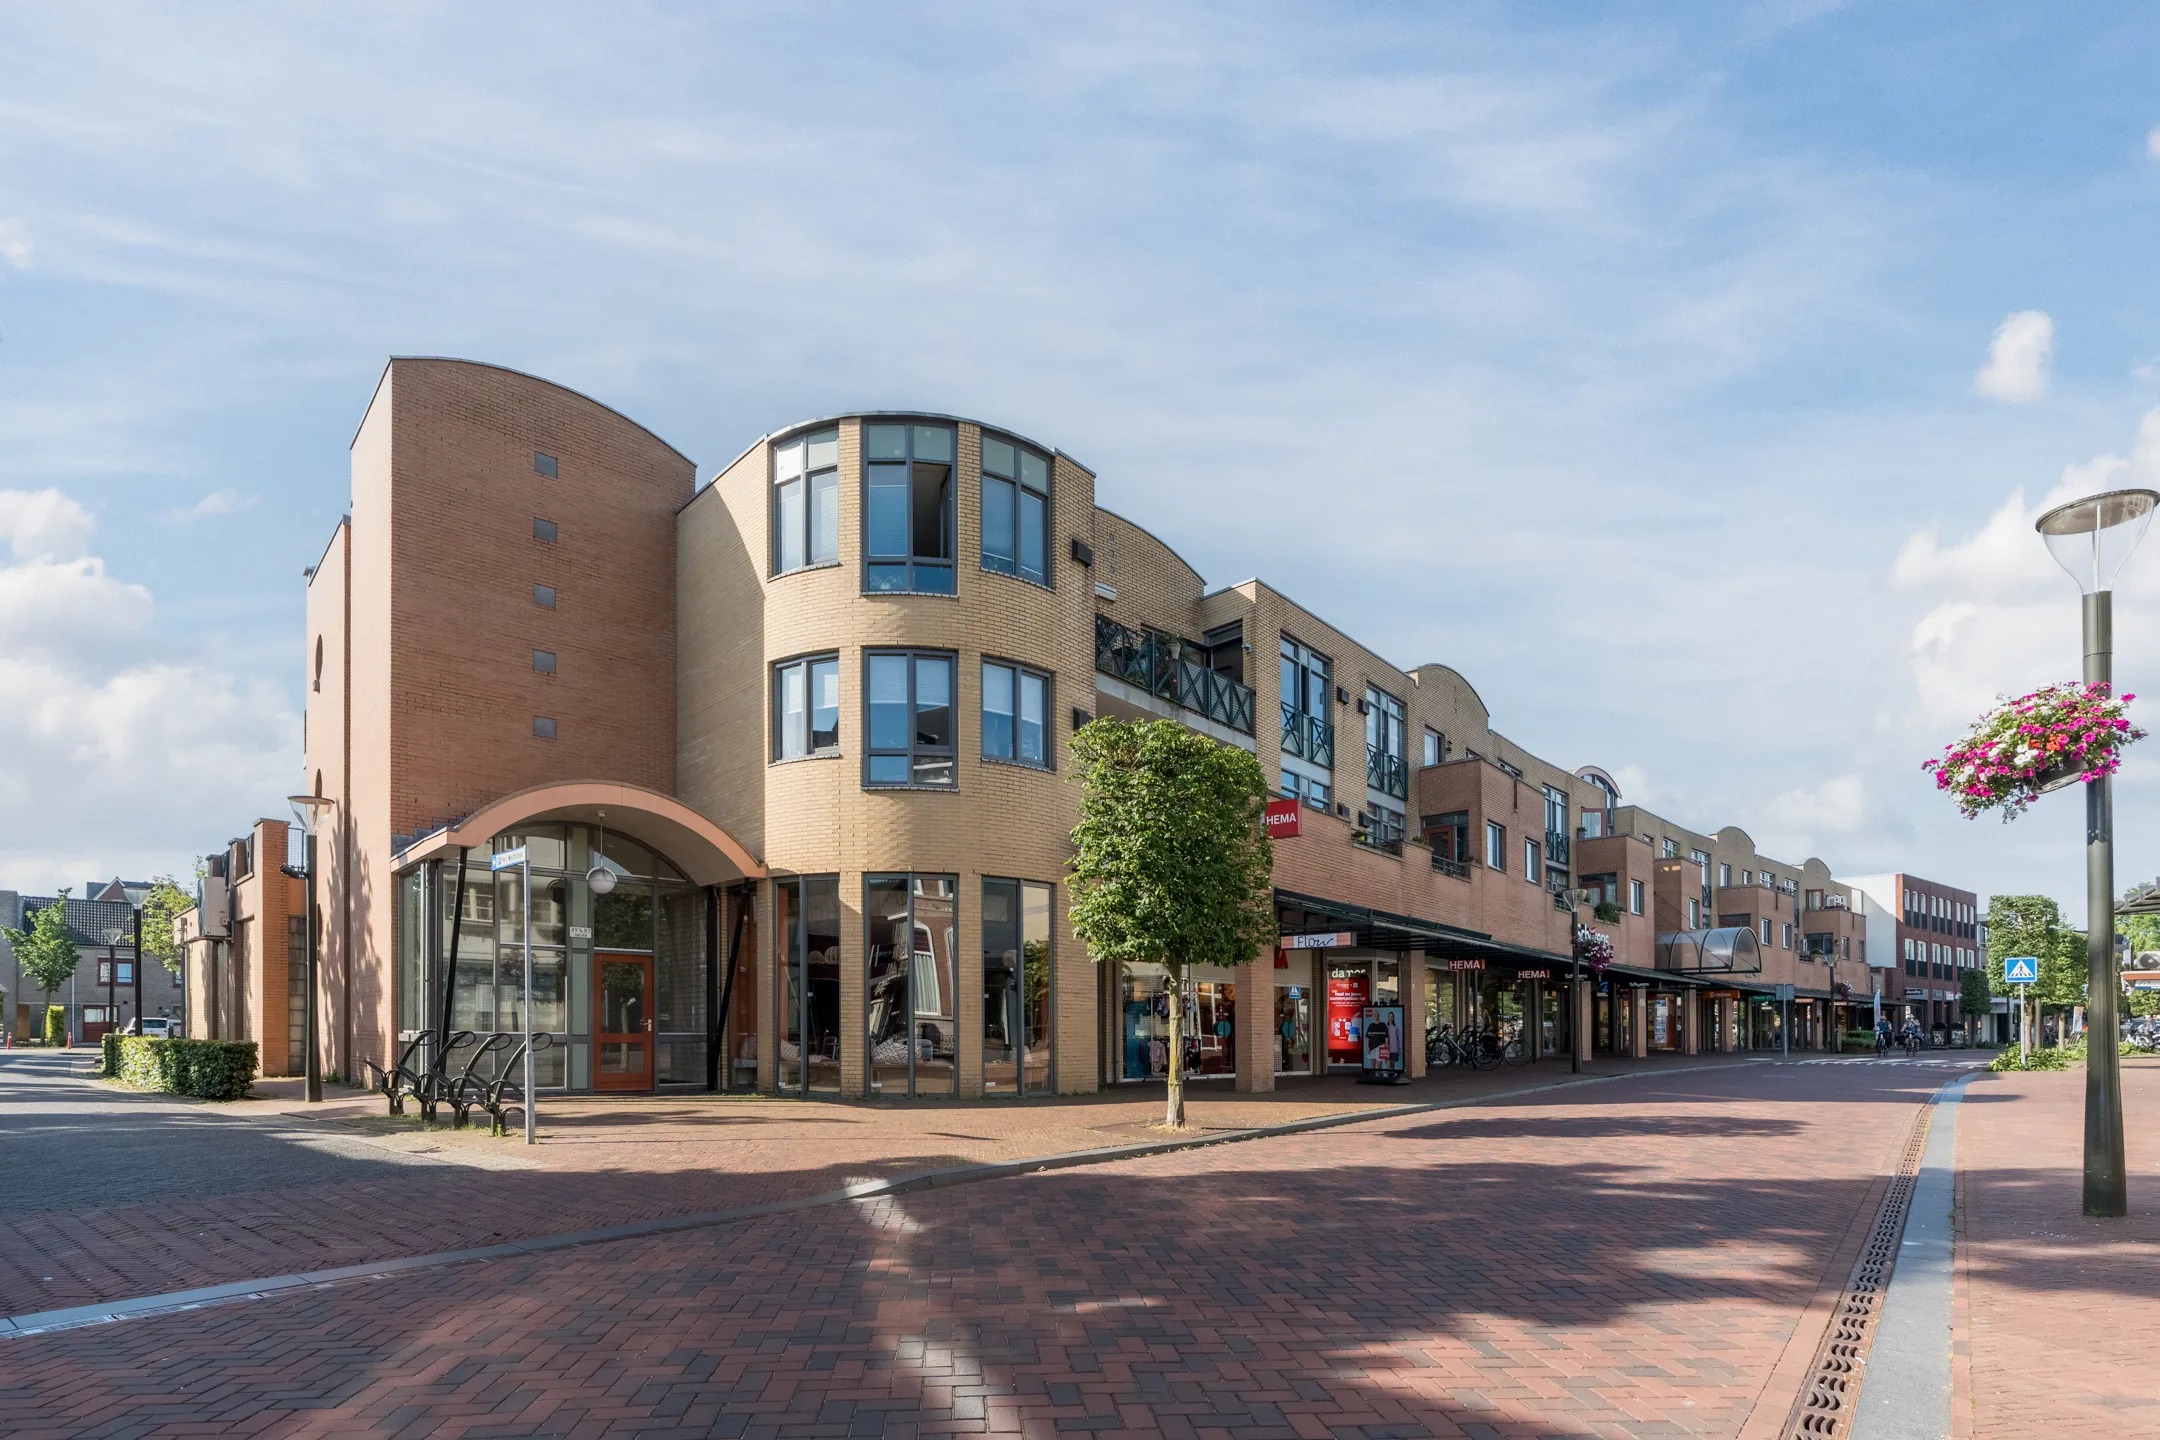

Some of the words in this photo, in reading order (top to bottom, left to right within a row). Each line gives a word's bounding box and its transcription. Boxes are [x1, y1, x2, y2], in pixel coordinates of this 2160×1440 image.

[1266, 812, 1297, 826] HEMA
[1297, 935, 1334, 948] Flow
[1449, 960, 1480, 970] HEMA
[1518, 970, 1546, 979] HEMA
